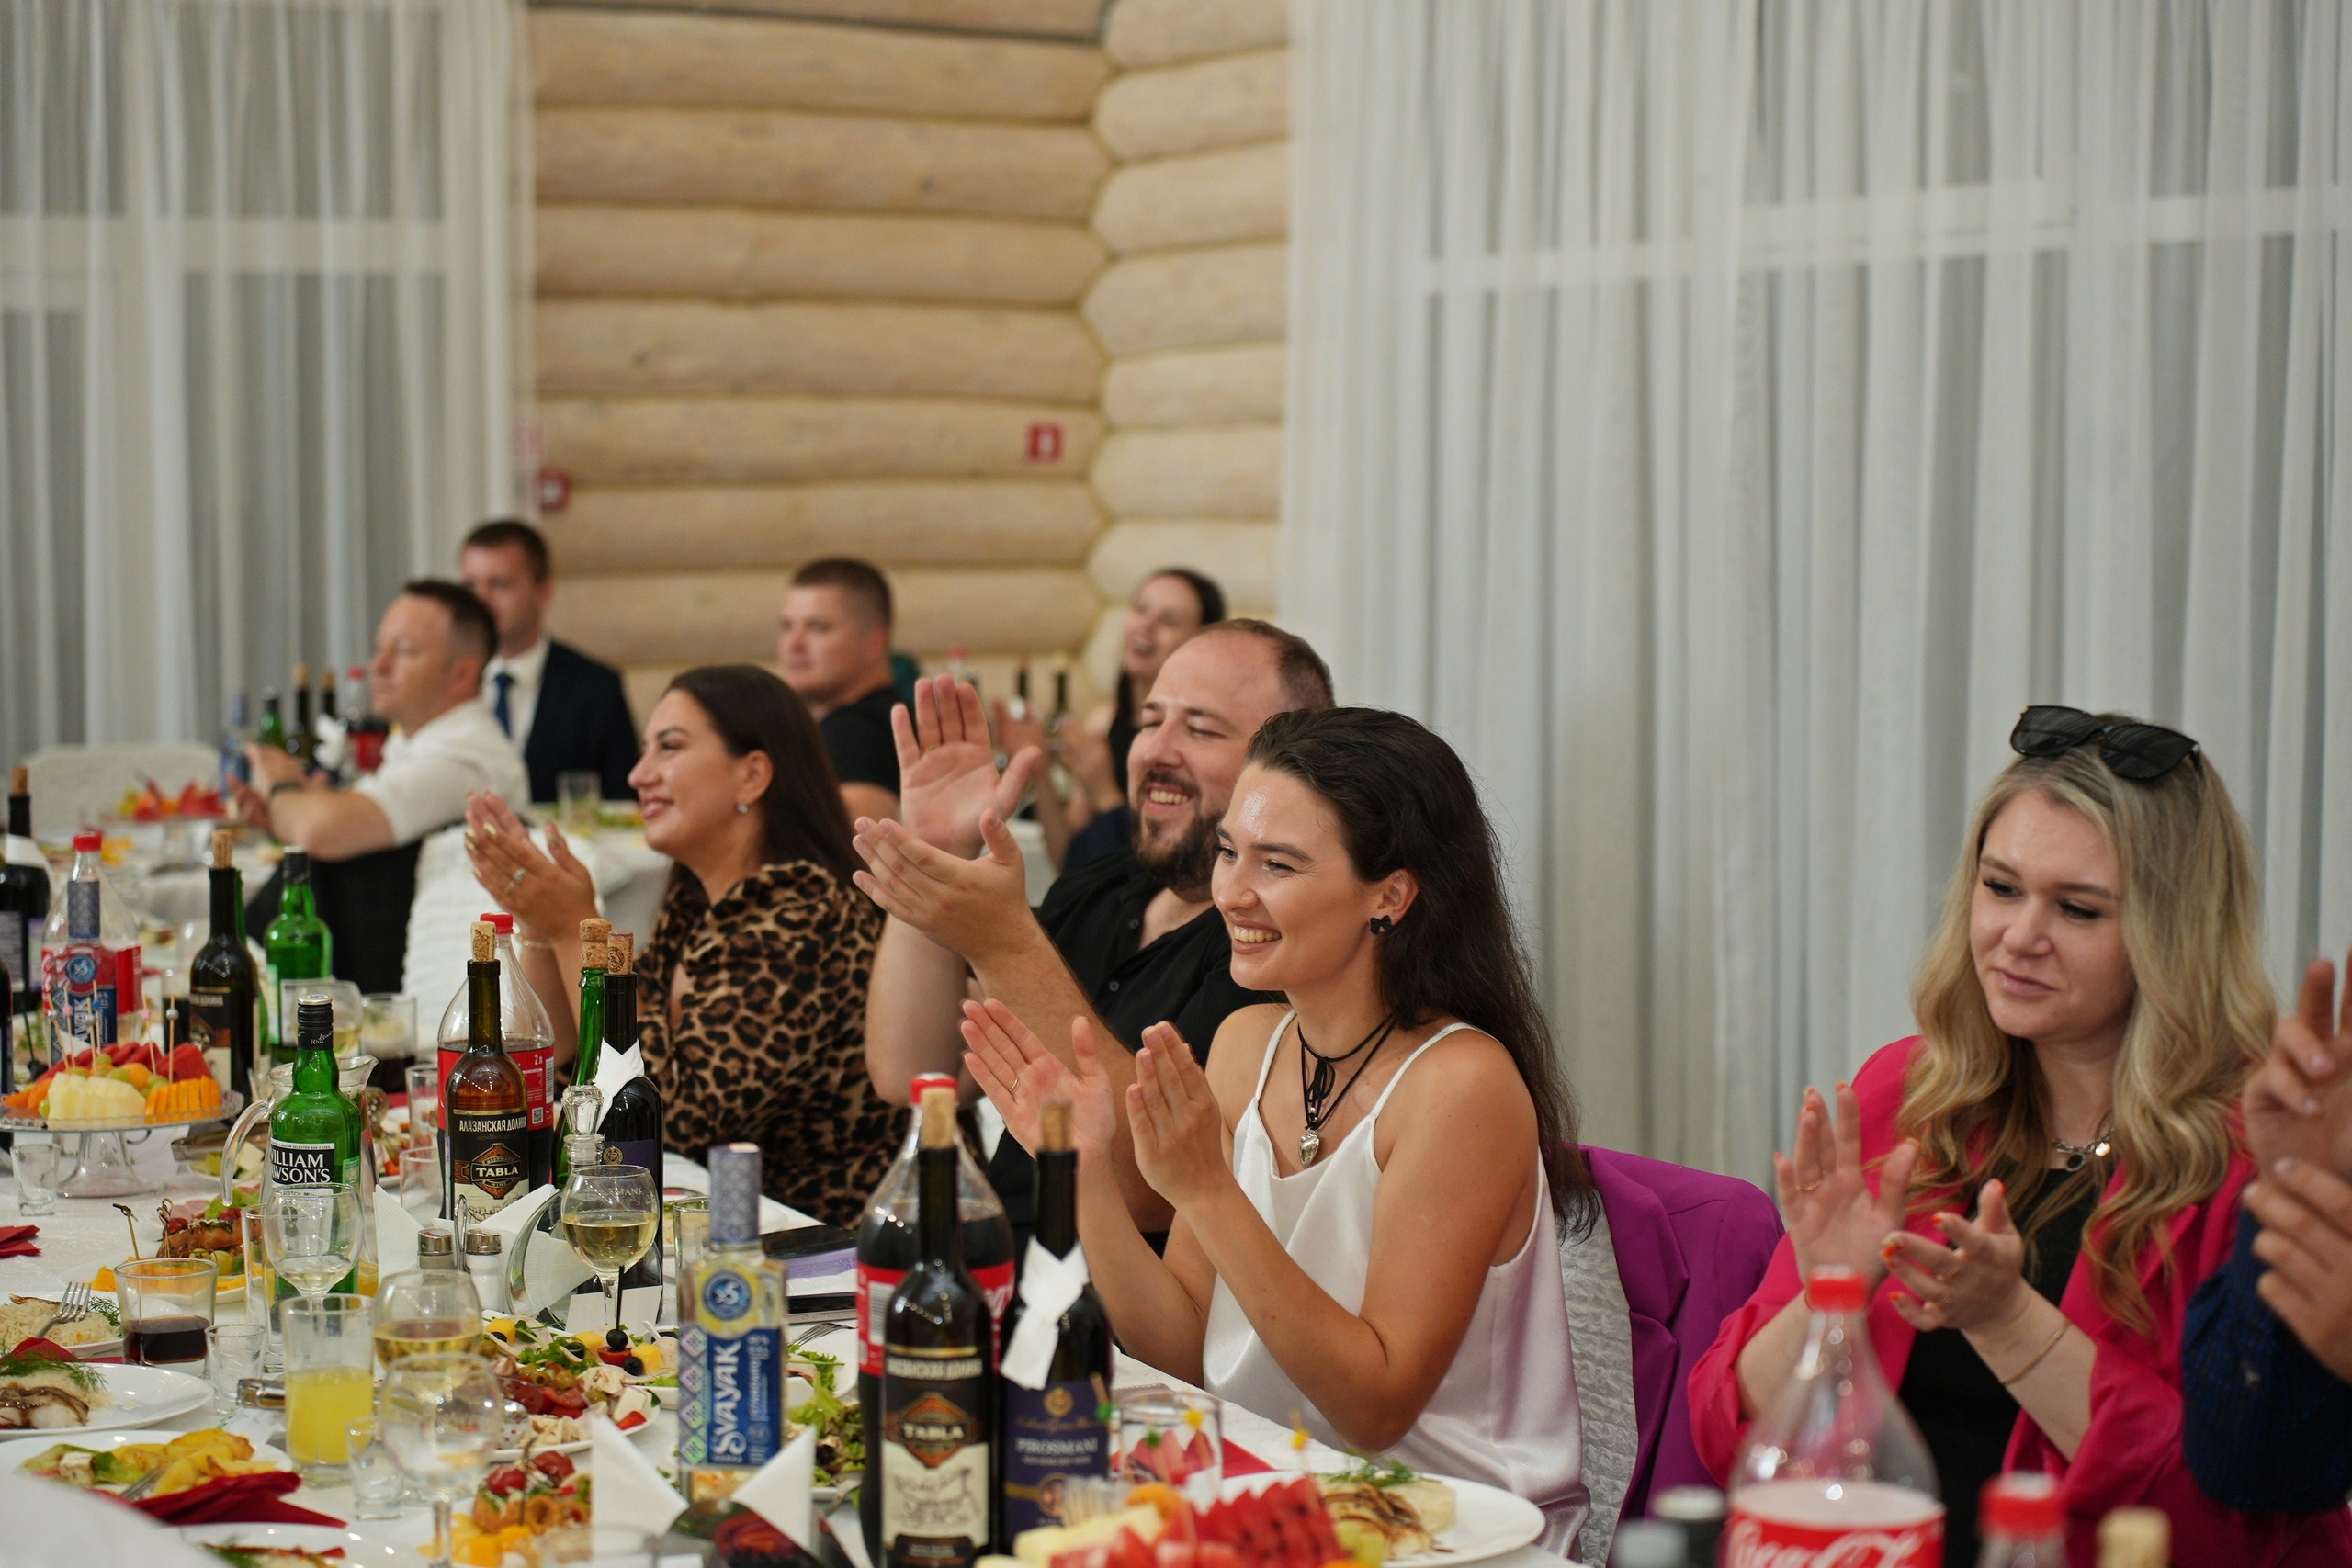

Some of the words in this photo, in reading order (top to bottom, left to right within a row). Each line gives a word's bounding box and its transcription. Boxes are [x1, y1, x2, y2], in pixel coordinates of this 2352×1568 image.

[459, 1119, 506, 1133] АЛАЗАНСКАЯ
[475, 1166, 519, 1178] TABLA
[903, 1425, 964, 1440] TABLA
